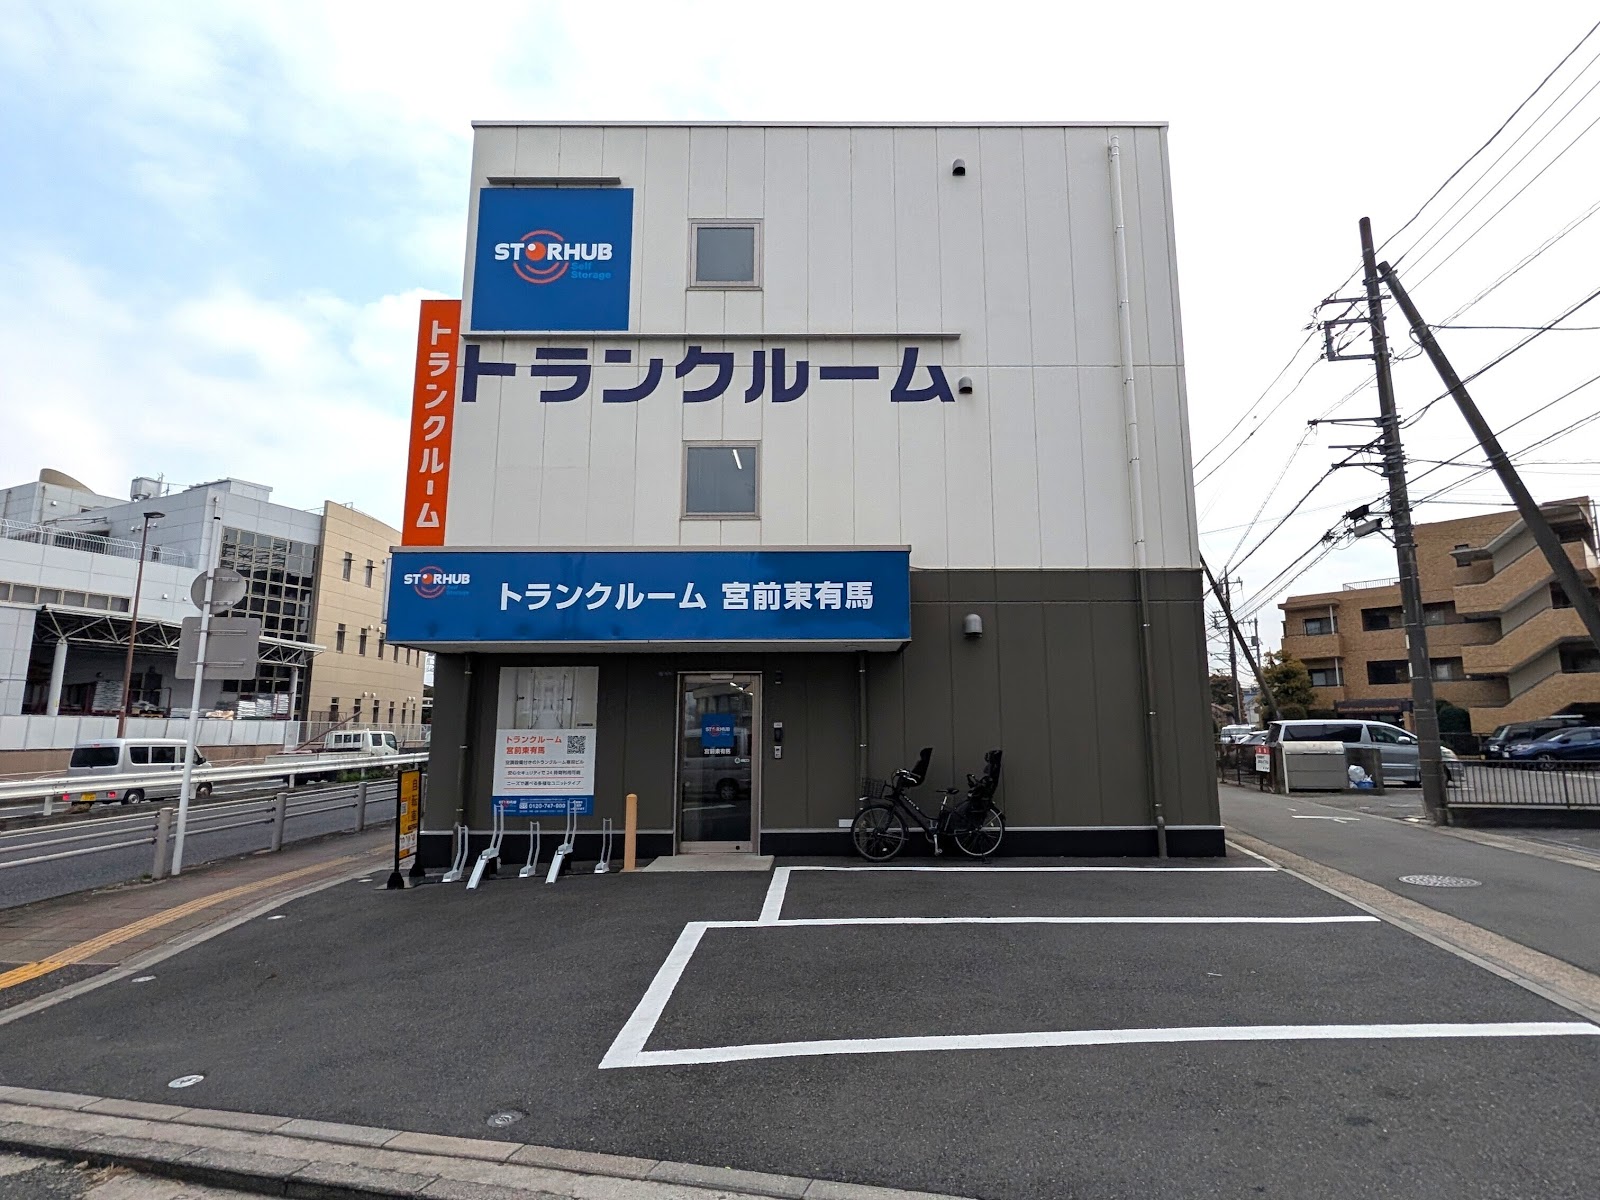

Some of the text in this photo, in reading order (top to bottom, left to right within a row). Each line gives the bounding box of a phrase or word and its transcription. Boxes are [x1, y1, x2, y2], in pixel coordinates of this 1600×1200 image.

[494, 241, 613, 261] STORHUB
[570, 261, 592, 271] Self
[570, 270, 612, 281] Storage
[461, 344, 956, 403] トランクルーム
[416, 319, 452, 528] トランクルーム
[403, 573, 471, 585] STORHUB
[499, 580, 875, 611] トランクルーム 宮前東有馬
[506, 735, 562, 743] トランクルーム
